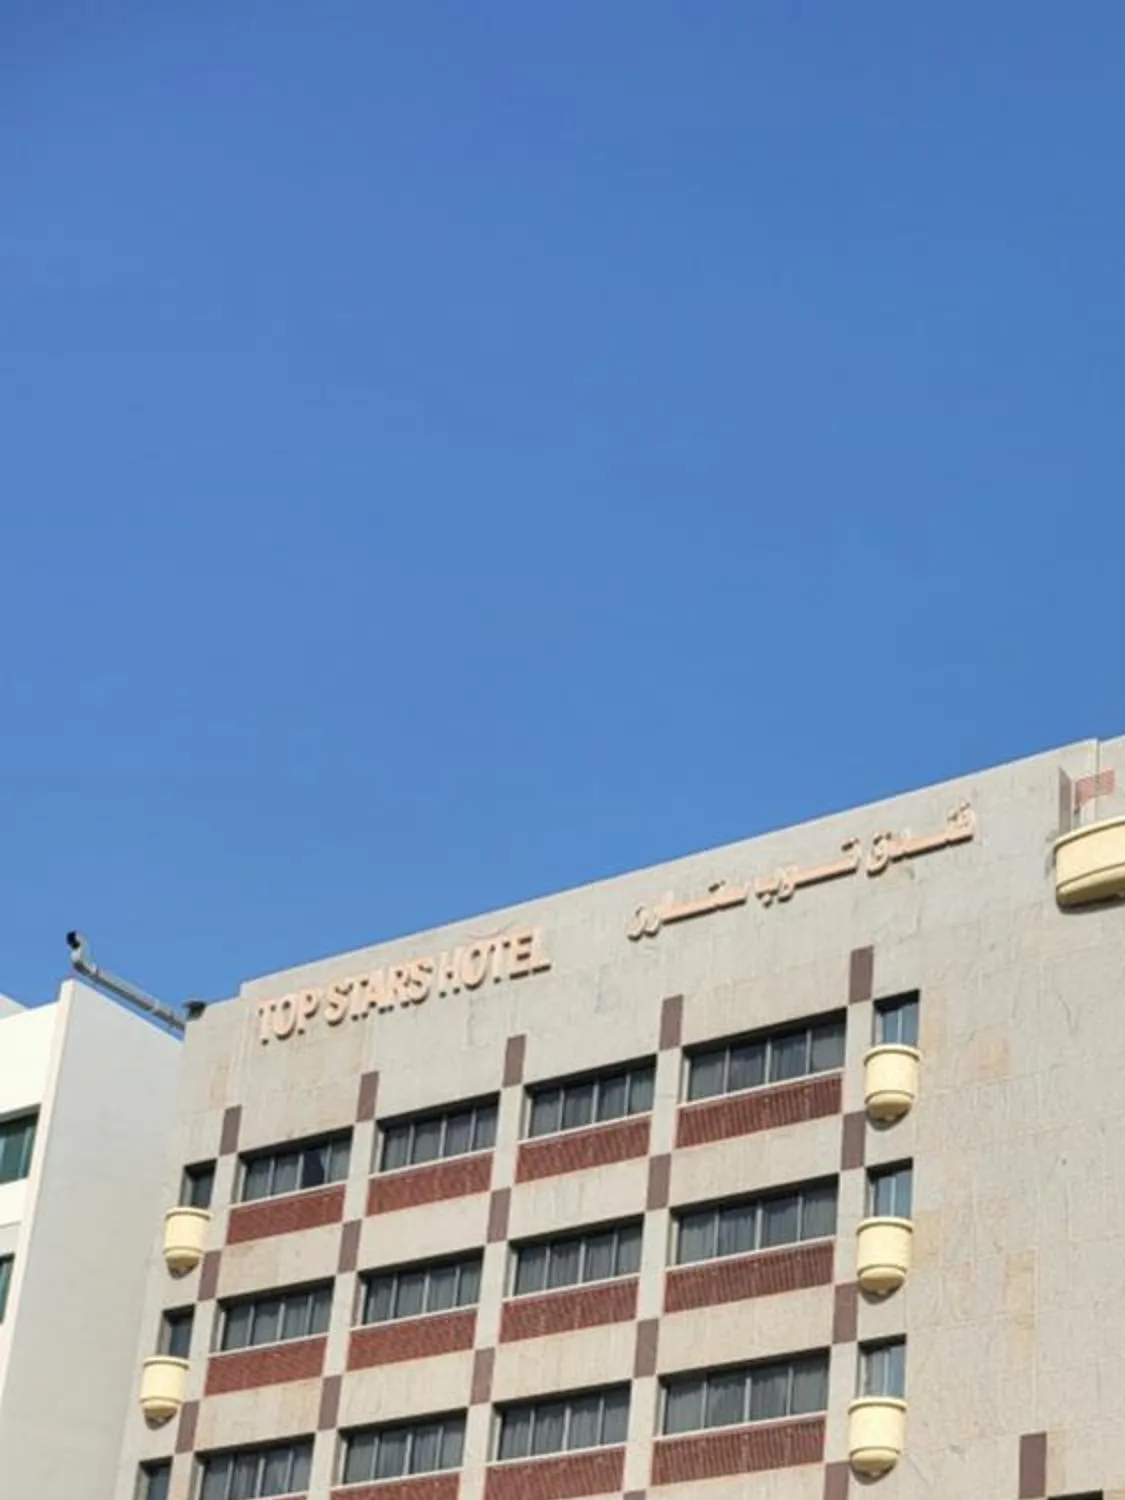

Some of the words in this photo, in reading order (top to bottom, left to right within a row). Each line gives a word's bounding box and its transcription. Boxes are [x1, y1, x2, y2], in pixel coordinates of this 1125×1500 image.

[258, 985, 321, 1046] TOP
[323, 955, 432, 1026] STARS
[437, 926, 551, 998] HOTEL
